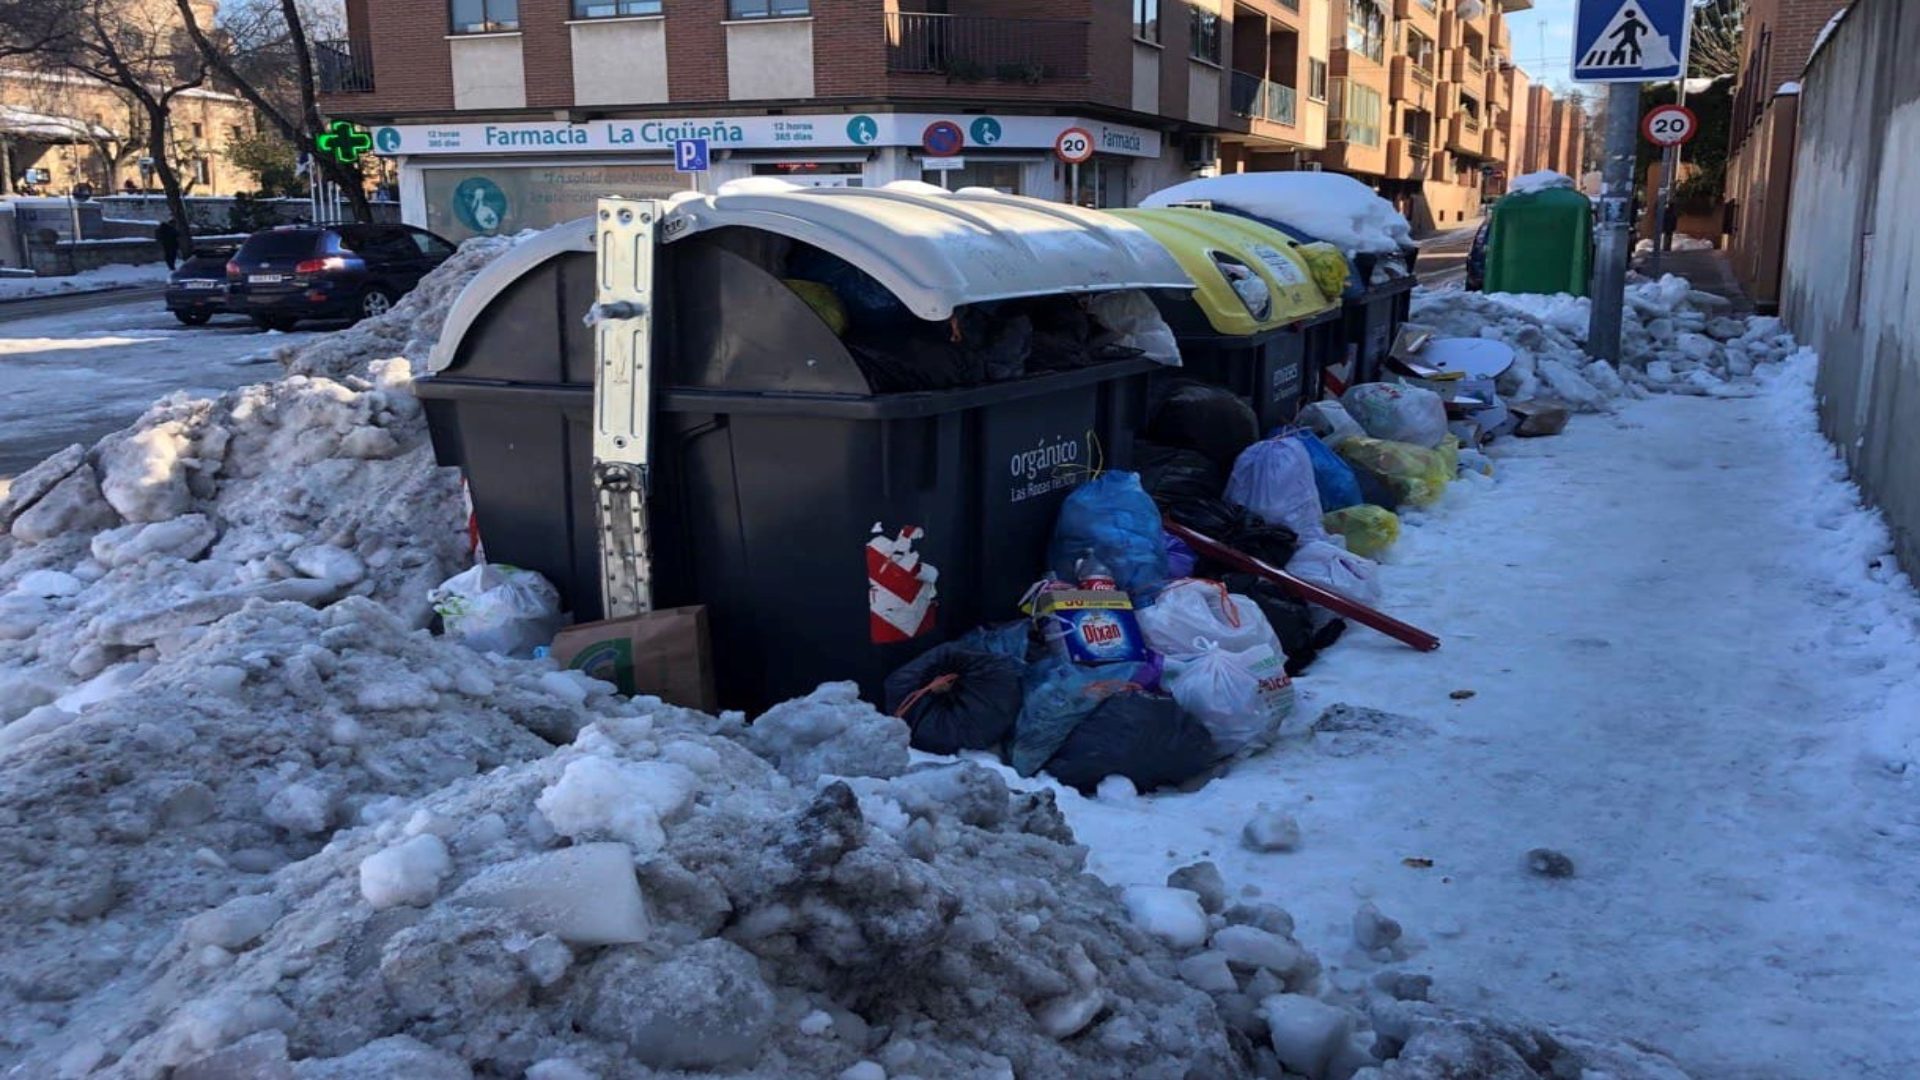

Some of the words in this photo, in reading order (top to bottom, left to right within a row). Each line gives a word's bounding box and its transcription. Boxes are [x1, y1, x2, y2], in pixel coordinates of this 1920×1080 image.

[485, 124, 588, 146] Farmacia
[608, 123, 635, 144] La
[641, 121, 743, 148] Cigüeña
[773, 122, 784, 131] 12
[786, 122, 813, 130] horas
[1655, 118, 1685, 133] 20
[775, 132, 791, 141] 365
[1063, 139, 1086, 152] 20
[1102, 126, 1141, 151] Farmacia
[681, 141, 696, 168] P
[1010, 434, 1078, 480] orgánico
[1011, 486, 1027, 502] Las
[1082, 622, 1122, 645] Dixan
